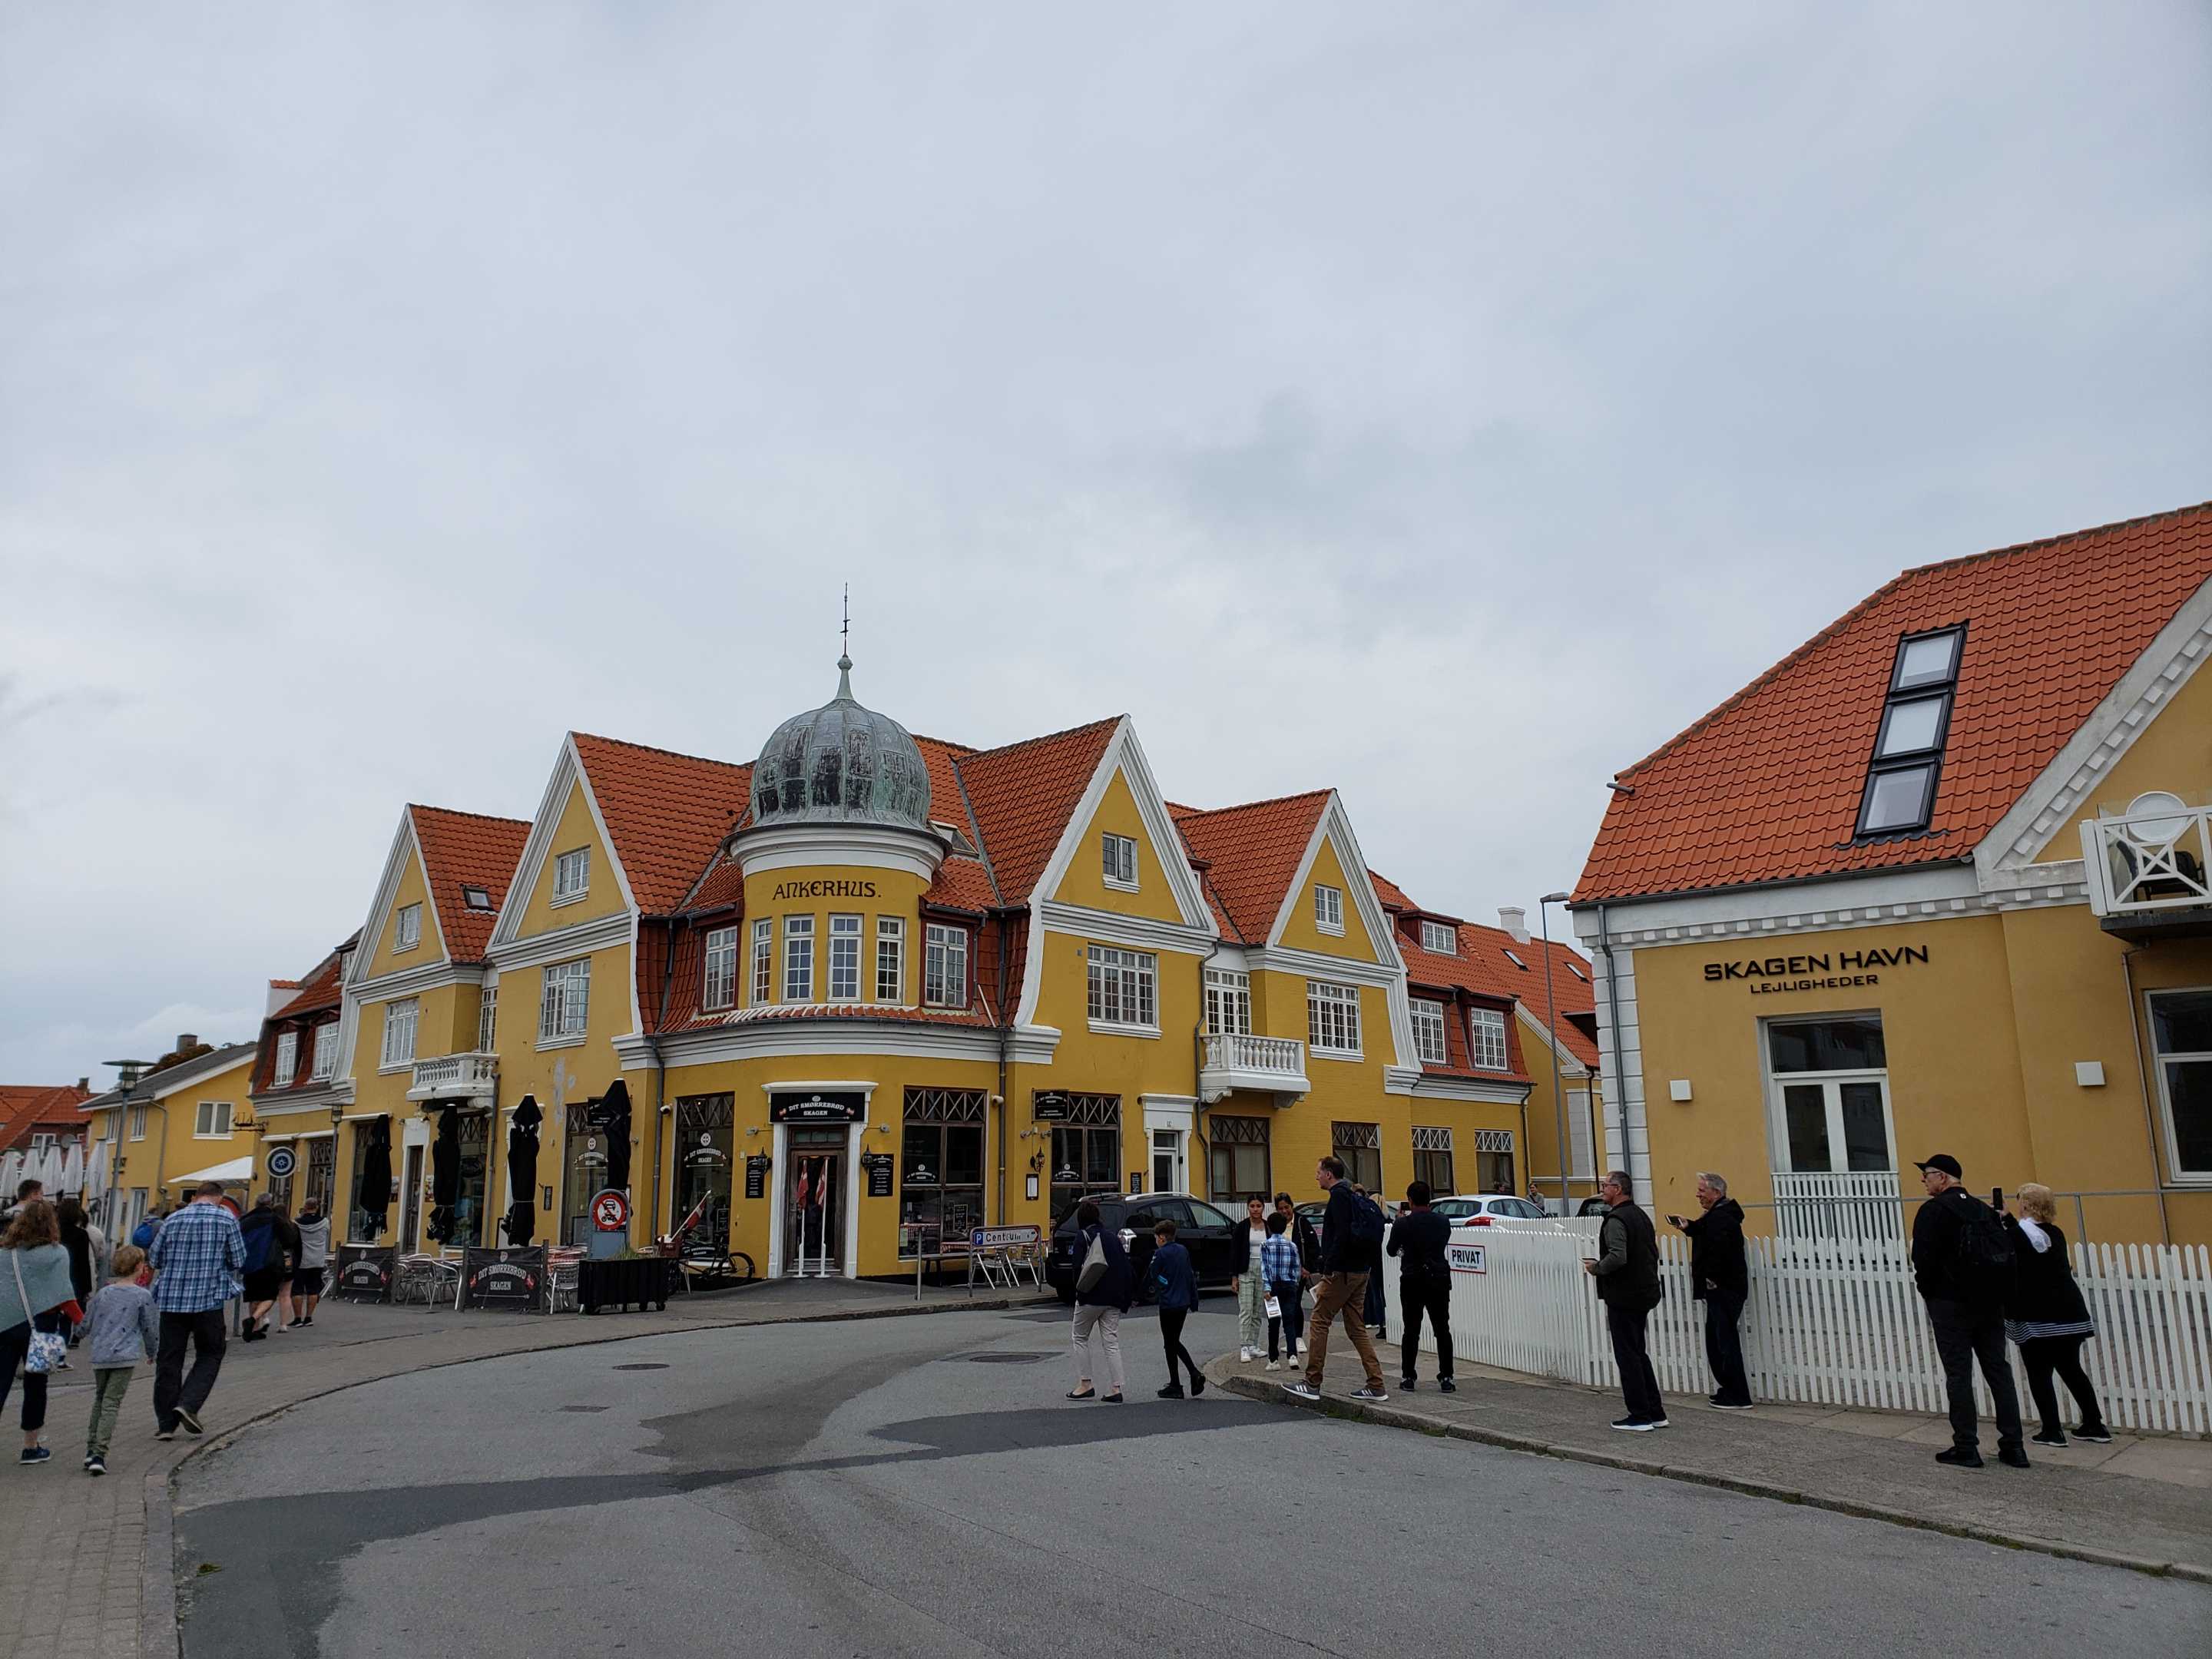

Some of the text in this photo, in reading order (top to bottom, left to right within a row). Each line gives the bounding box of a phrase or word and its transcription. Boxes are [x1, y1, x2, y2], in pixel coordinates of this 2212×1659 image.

[1704, 945, 1929, 981] SKAGEN HAVN
[1750, 975, 1879, 994] LEJLIGHEDER
[800, 1101, 845, 1111] SMØRREBRØD
[976, 1233, 982, 1244] P
[1452, 1249, 1481, 1264] PRIVAT
[478, 1267, 488, 1281] DIT
[490, 1281, 512, 1290] SKAGEN
